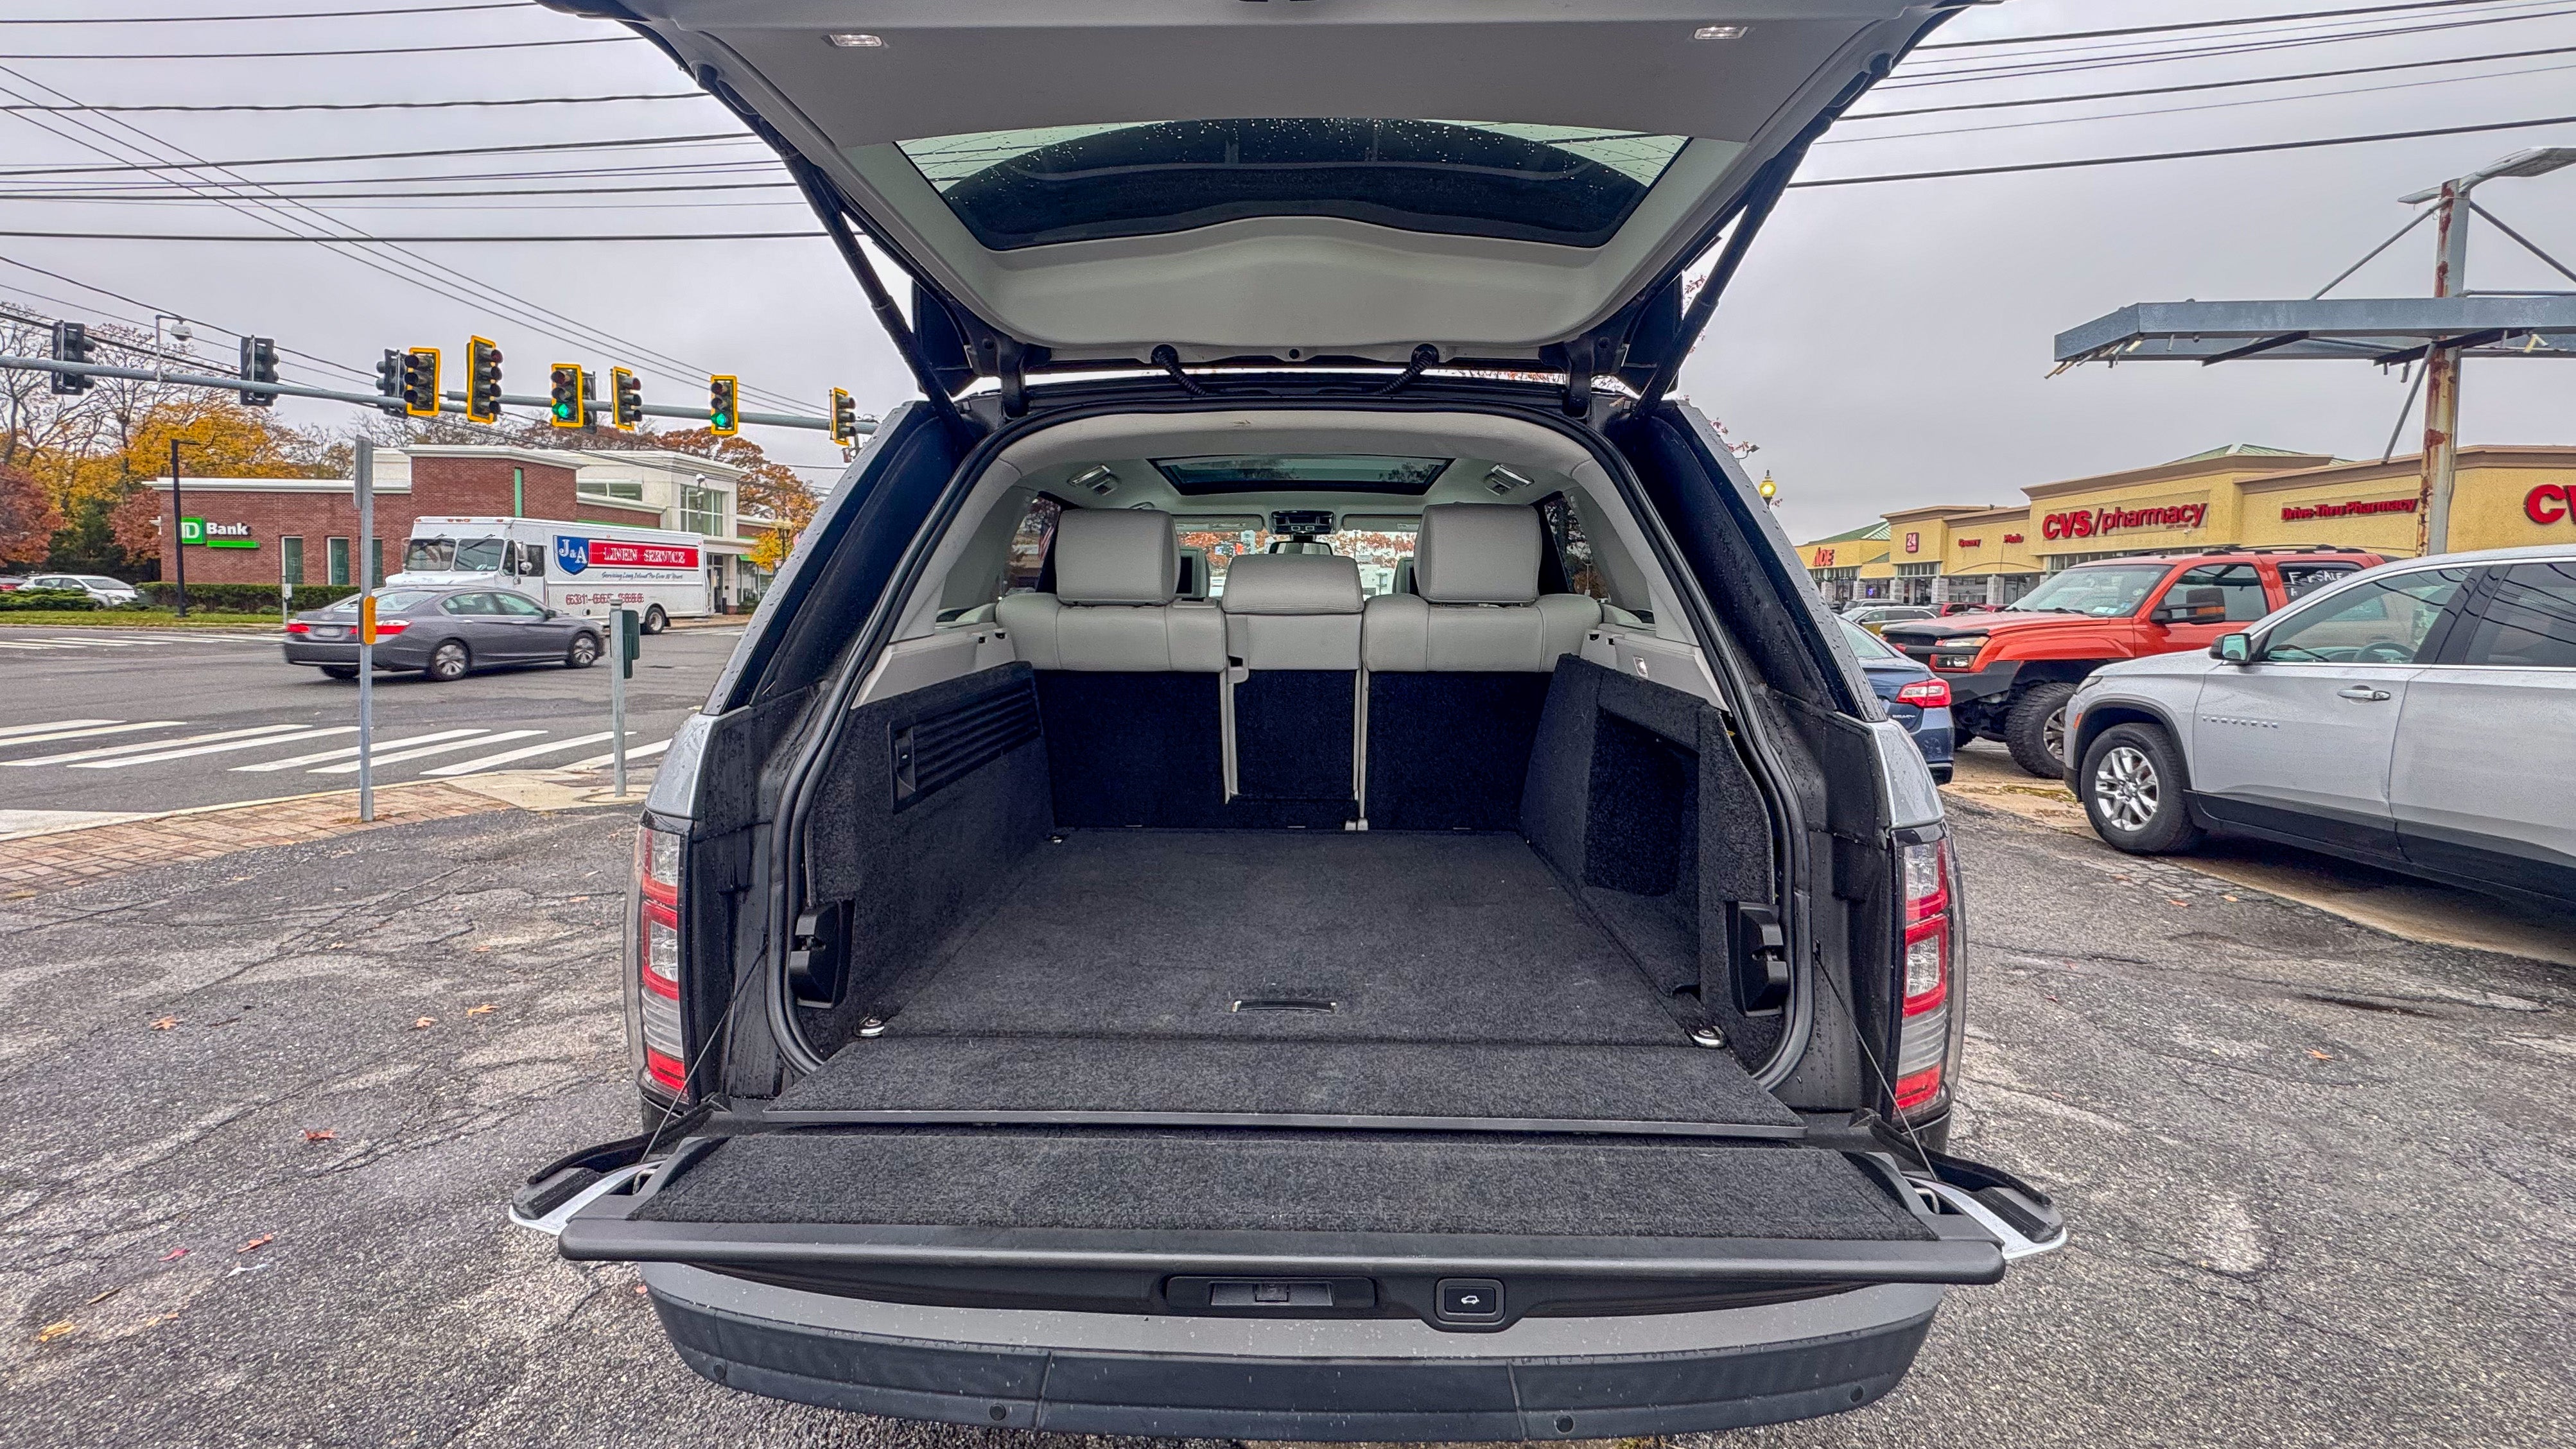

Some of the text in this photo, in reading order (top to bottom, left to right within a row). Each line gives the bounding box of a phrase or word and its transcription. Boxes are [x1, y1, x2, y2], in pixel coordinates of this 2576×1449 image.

[2345, 498, 2418, 516] Pharmacy
[206, 522, 250, 535] Bank
[2042, 503, 2207, 540] CVS/pharmacy
[1907, 534, 1917, 546] 24
[559, 539, 587, 564] J&A
[604, 547, 686, 564] LINEN SERVICE
[2315, 570, 2344, 582] SALE
